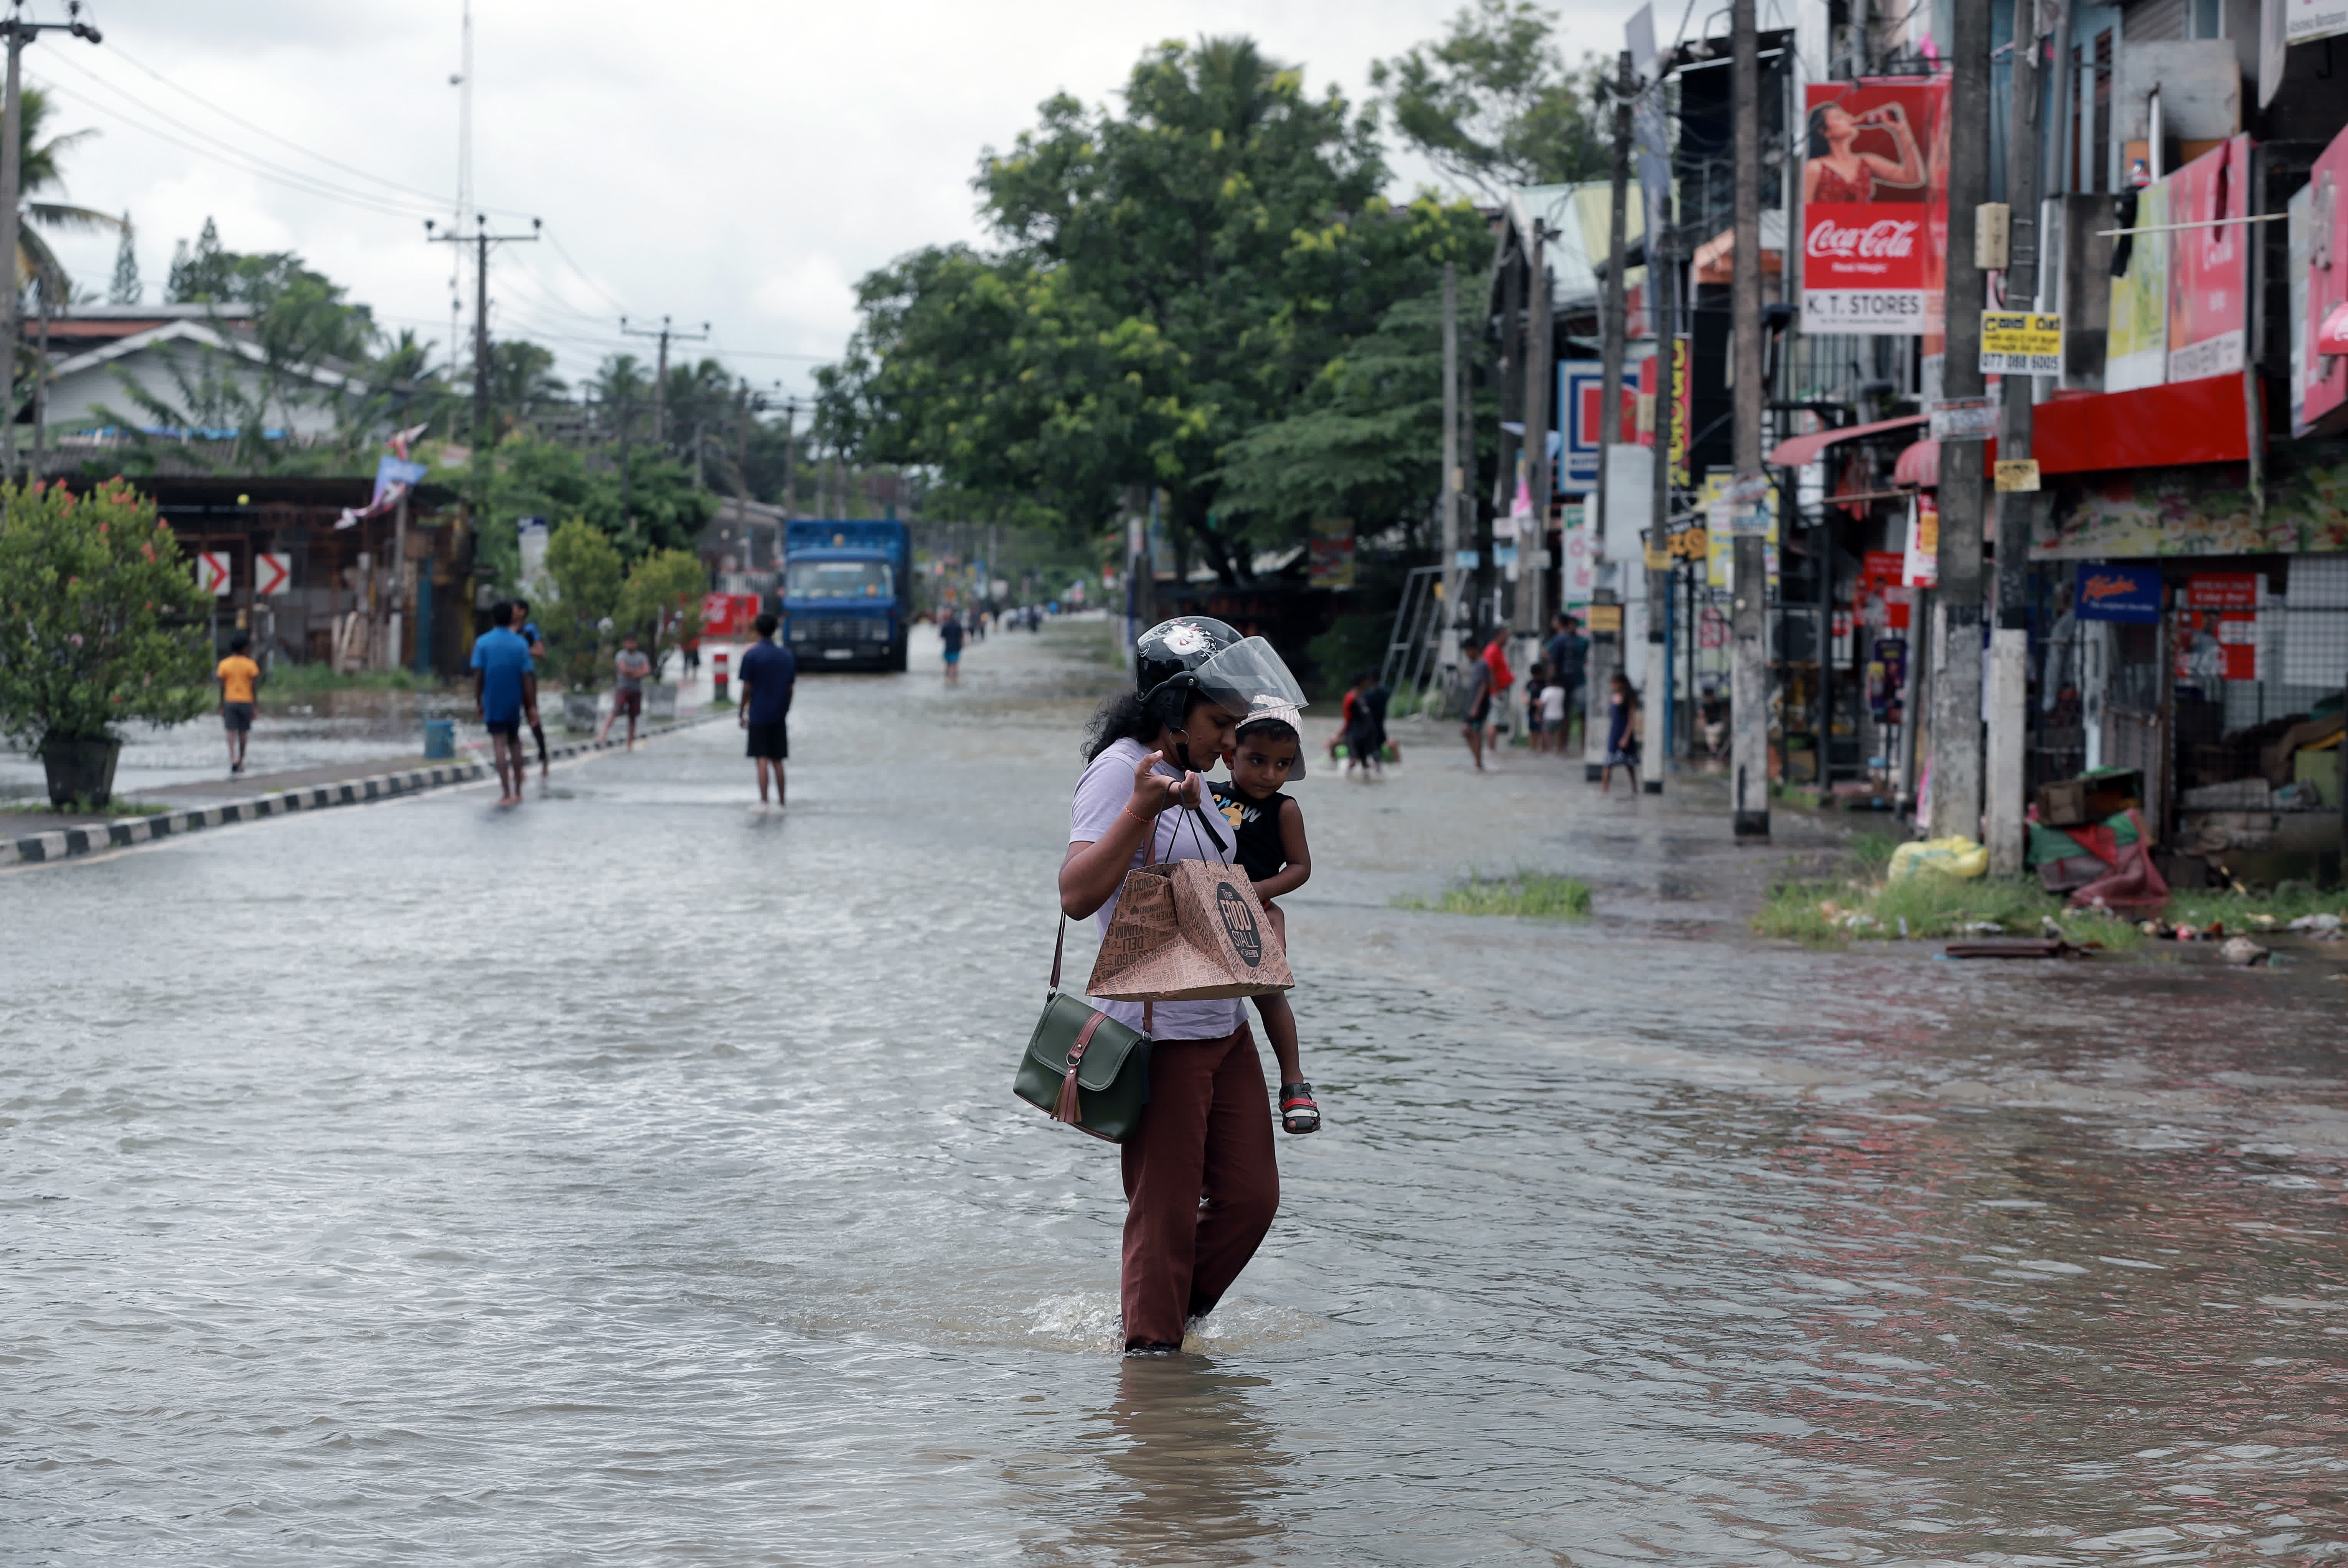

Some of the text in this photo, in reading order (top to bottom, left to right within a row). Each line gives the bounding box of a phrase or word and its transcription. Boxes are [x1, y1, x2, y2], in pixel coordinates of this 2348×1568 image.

[1807, 219, 1919, 258] Coca-Cola
[1829, 294, 1845, 315] T.
[1850, 294, 1920, 315] STORES
[1221, 889, 1233, 899] The
[1139, 903, 1164, 915] CRUNCHY
[1219, 899, 1252, 931] FOOD
[1232, 930, 1259, 948] STALL
[1138, 940, 1185, 959] GOODNESS
[1114, 954, 1128, 967] GO!
[1131, 953, 1162, 970] YUMMY
[1116, 968, 1141, 984] SIMPLY
[1144, 975, 1162, 985] FRESH
[1209, 970, 1228, 983] GOOD
